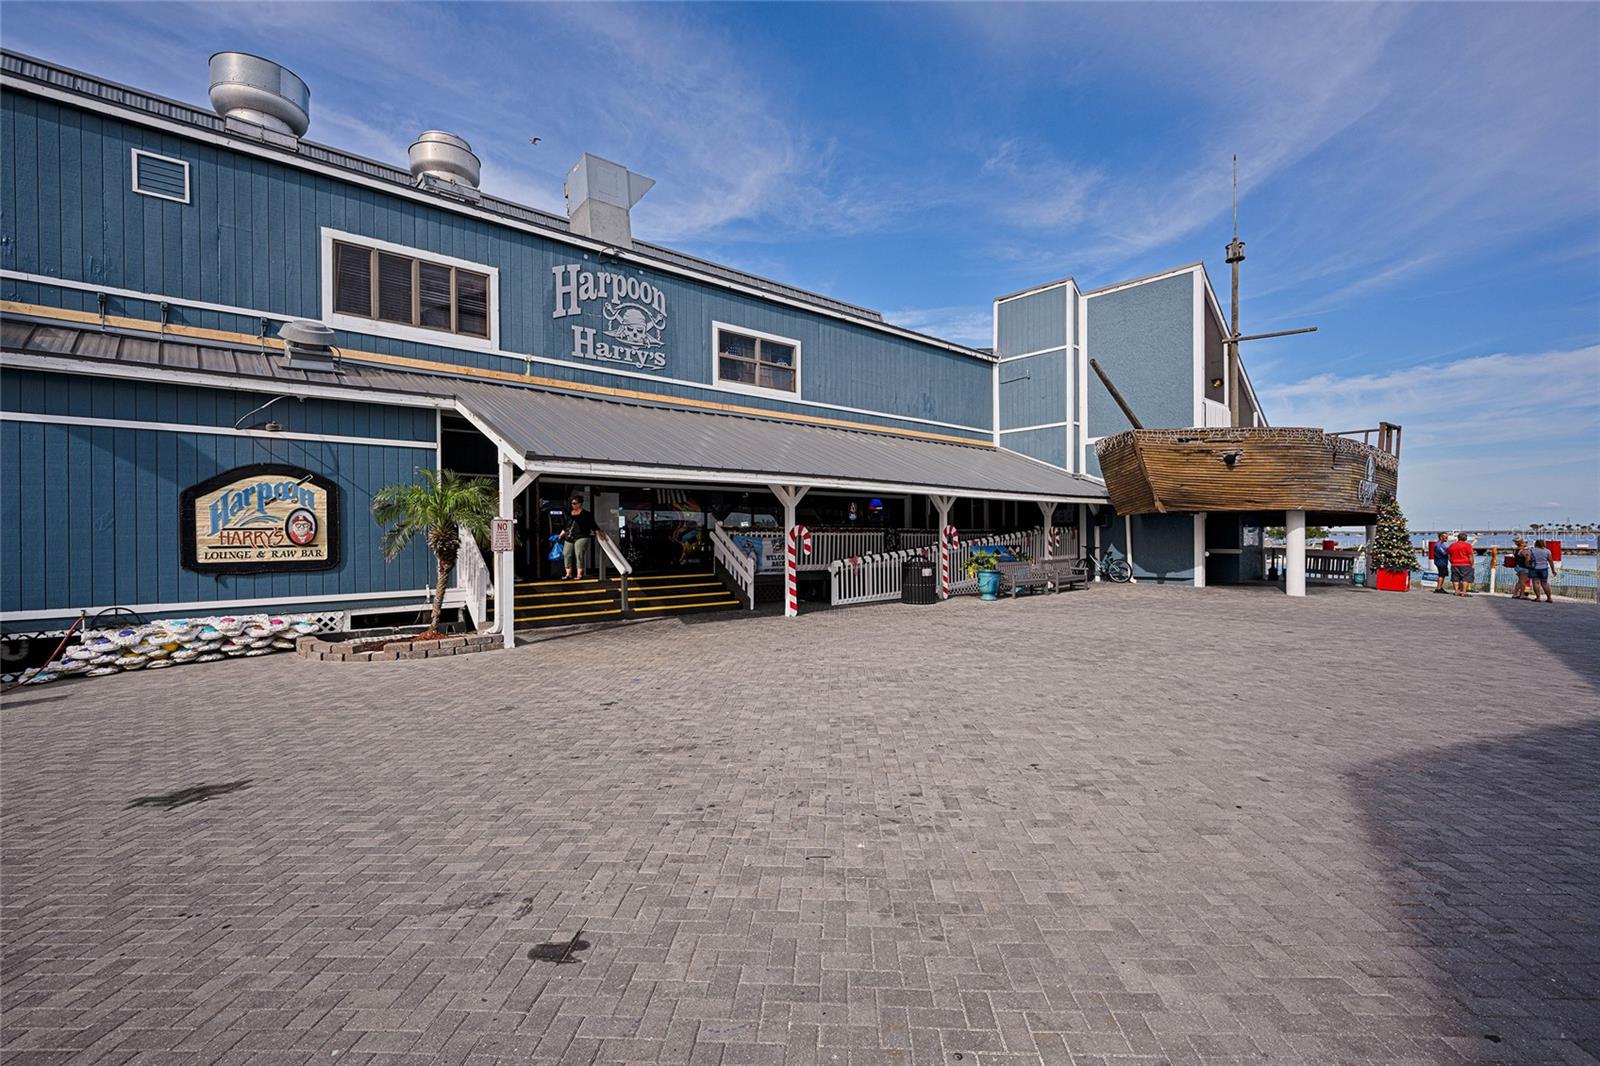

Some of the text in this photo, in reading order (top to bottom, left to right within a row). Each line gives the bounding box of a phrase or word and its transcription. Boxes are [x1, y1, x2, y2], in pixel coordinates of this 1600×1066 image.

[552, 264, 667, 318] Harpoon
[571, 325, 666, 368] Harry's
[207, 480, 315, 537] Harpoon
[218, 527, 284, 549] HARRY'S
[497, 523, 508, 531] NO
[204, 549, 323, 560] LOUNGE & RAW BAR
